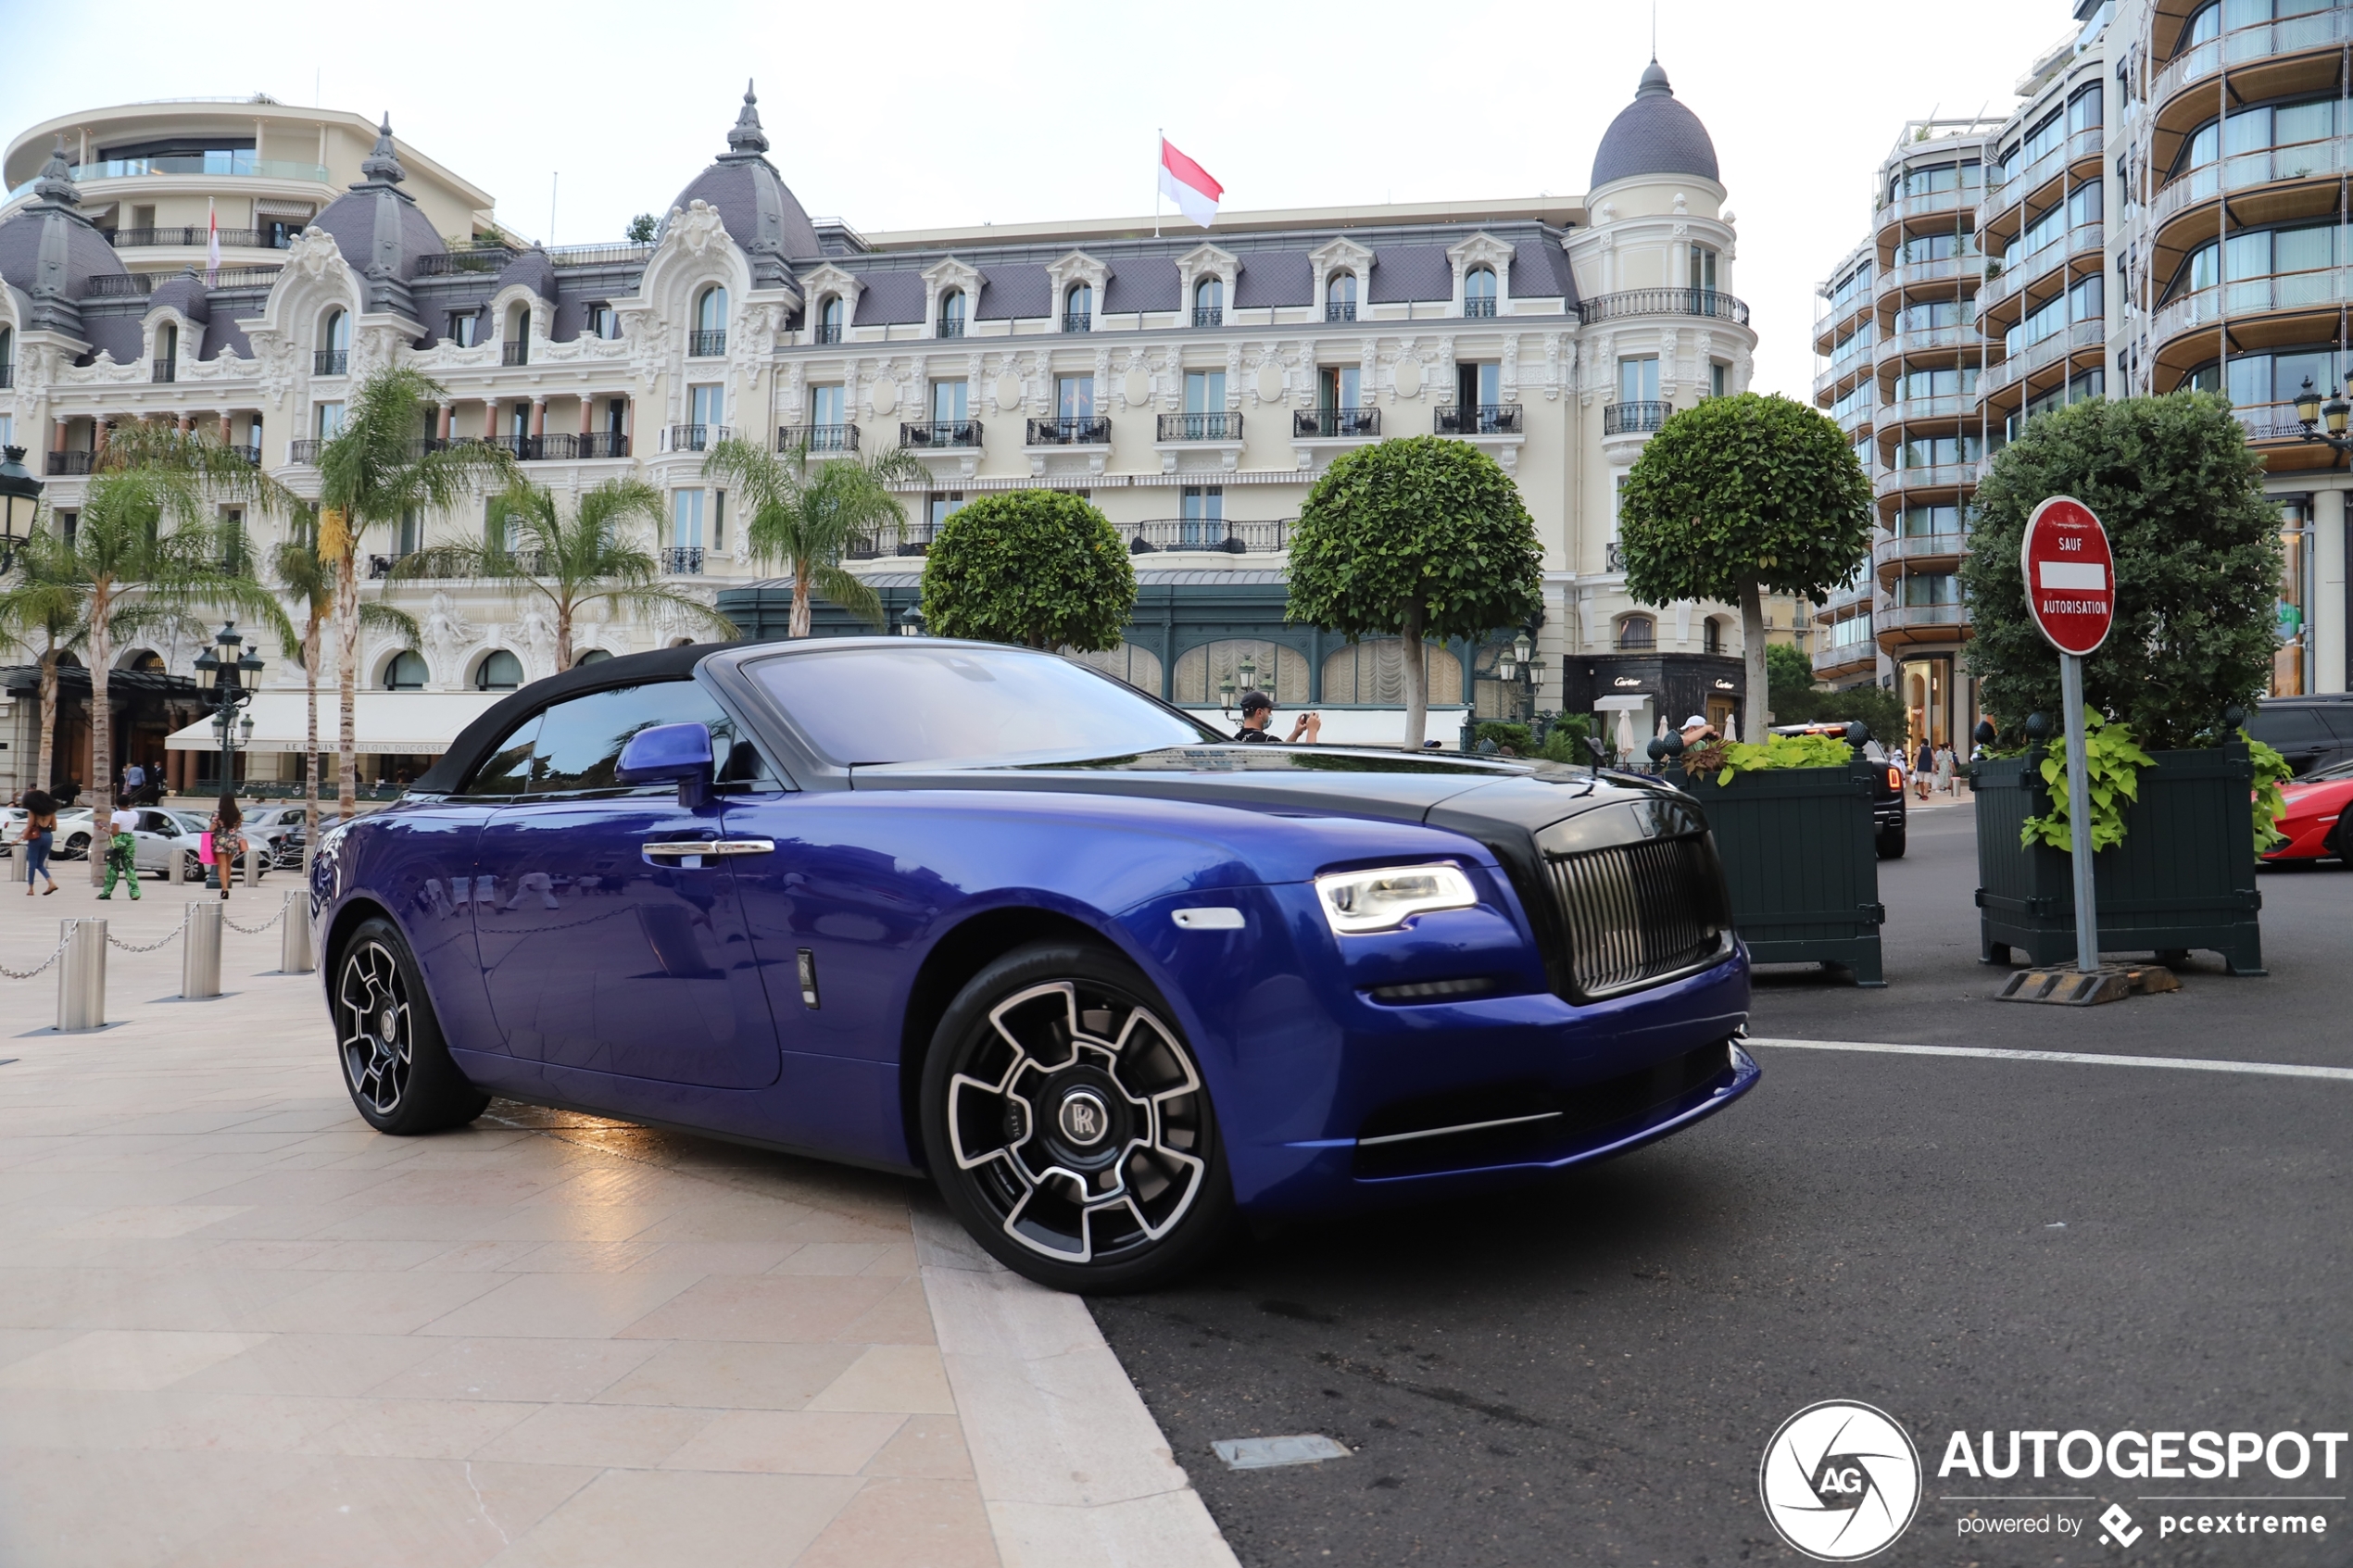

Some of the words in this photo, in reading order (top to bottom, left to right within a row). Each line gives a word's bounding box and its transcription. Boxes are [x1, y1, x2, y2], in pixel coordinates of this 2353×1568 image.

[2058, 537, 2082, 551] SAUF
[2043, 600, 2107, 614] AUTORISATION
[1615, 677, 1642, 686] Cartier
[1715, 679, 1734, 689] Cartier
[285, 743, 298, 751] LE
[303, 743, 335, 752] LUIS
